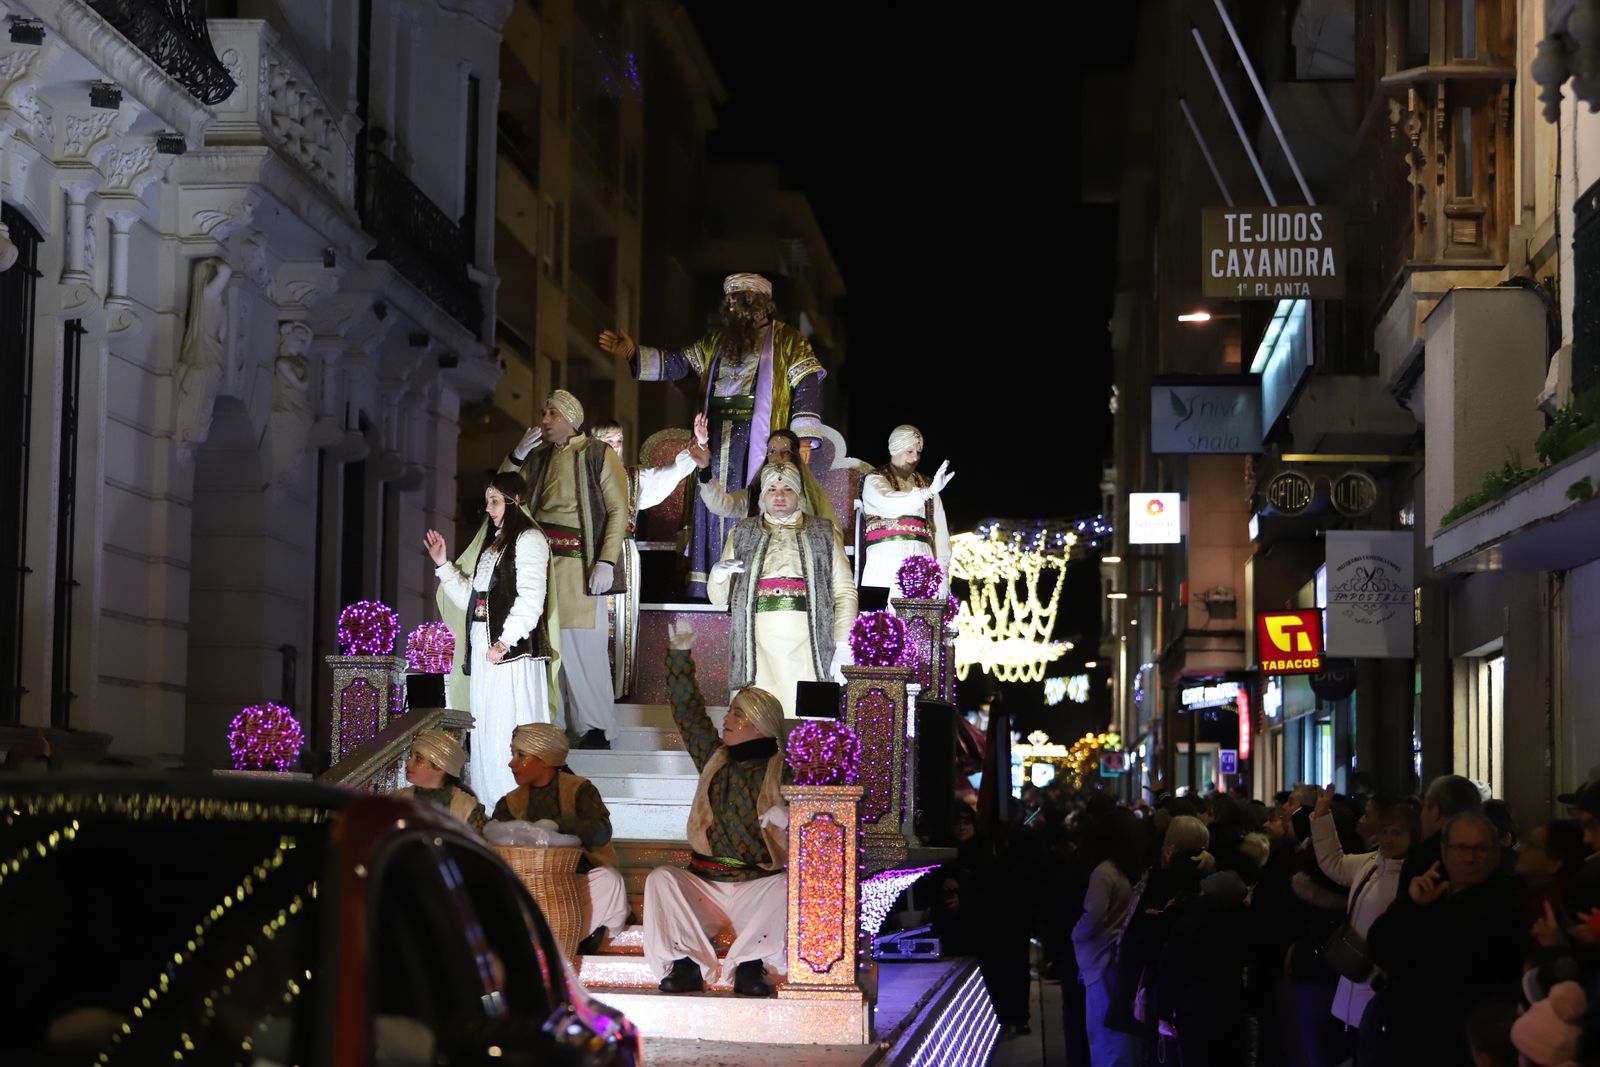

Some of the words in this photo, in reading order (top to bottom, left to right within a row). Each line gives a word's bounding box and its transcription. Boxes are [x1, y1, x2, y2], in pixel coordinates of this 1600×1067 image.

[1224, 212, 1323, 243] TEJIDOS
[1210, 247, 1336, 278] CAXANDRA
[1255, 282, 1311, 297] PLANTA
[1261, 658, 1320, 671] TABACOS
